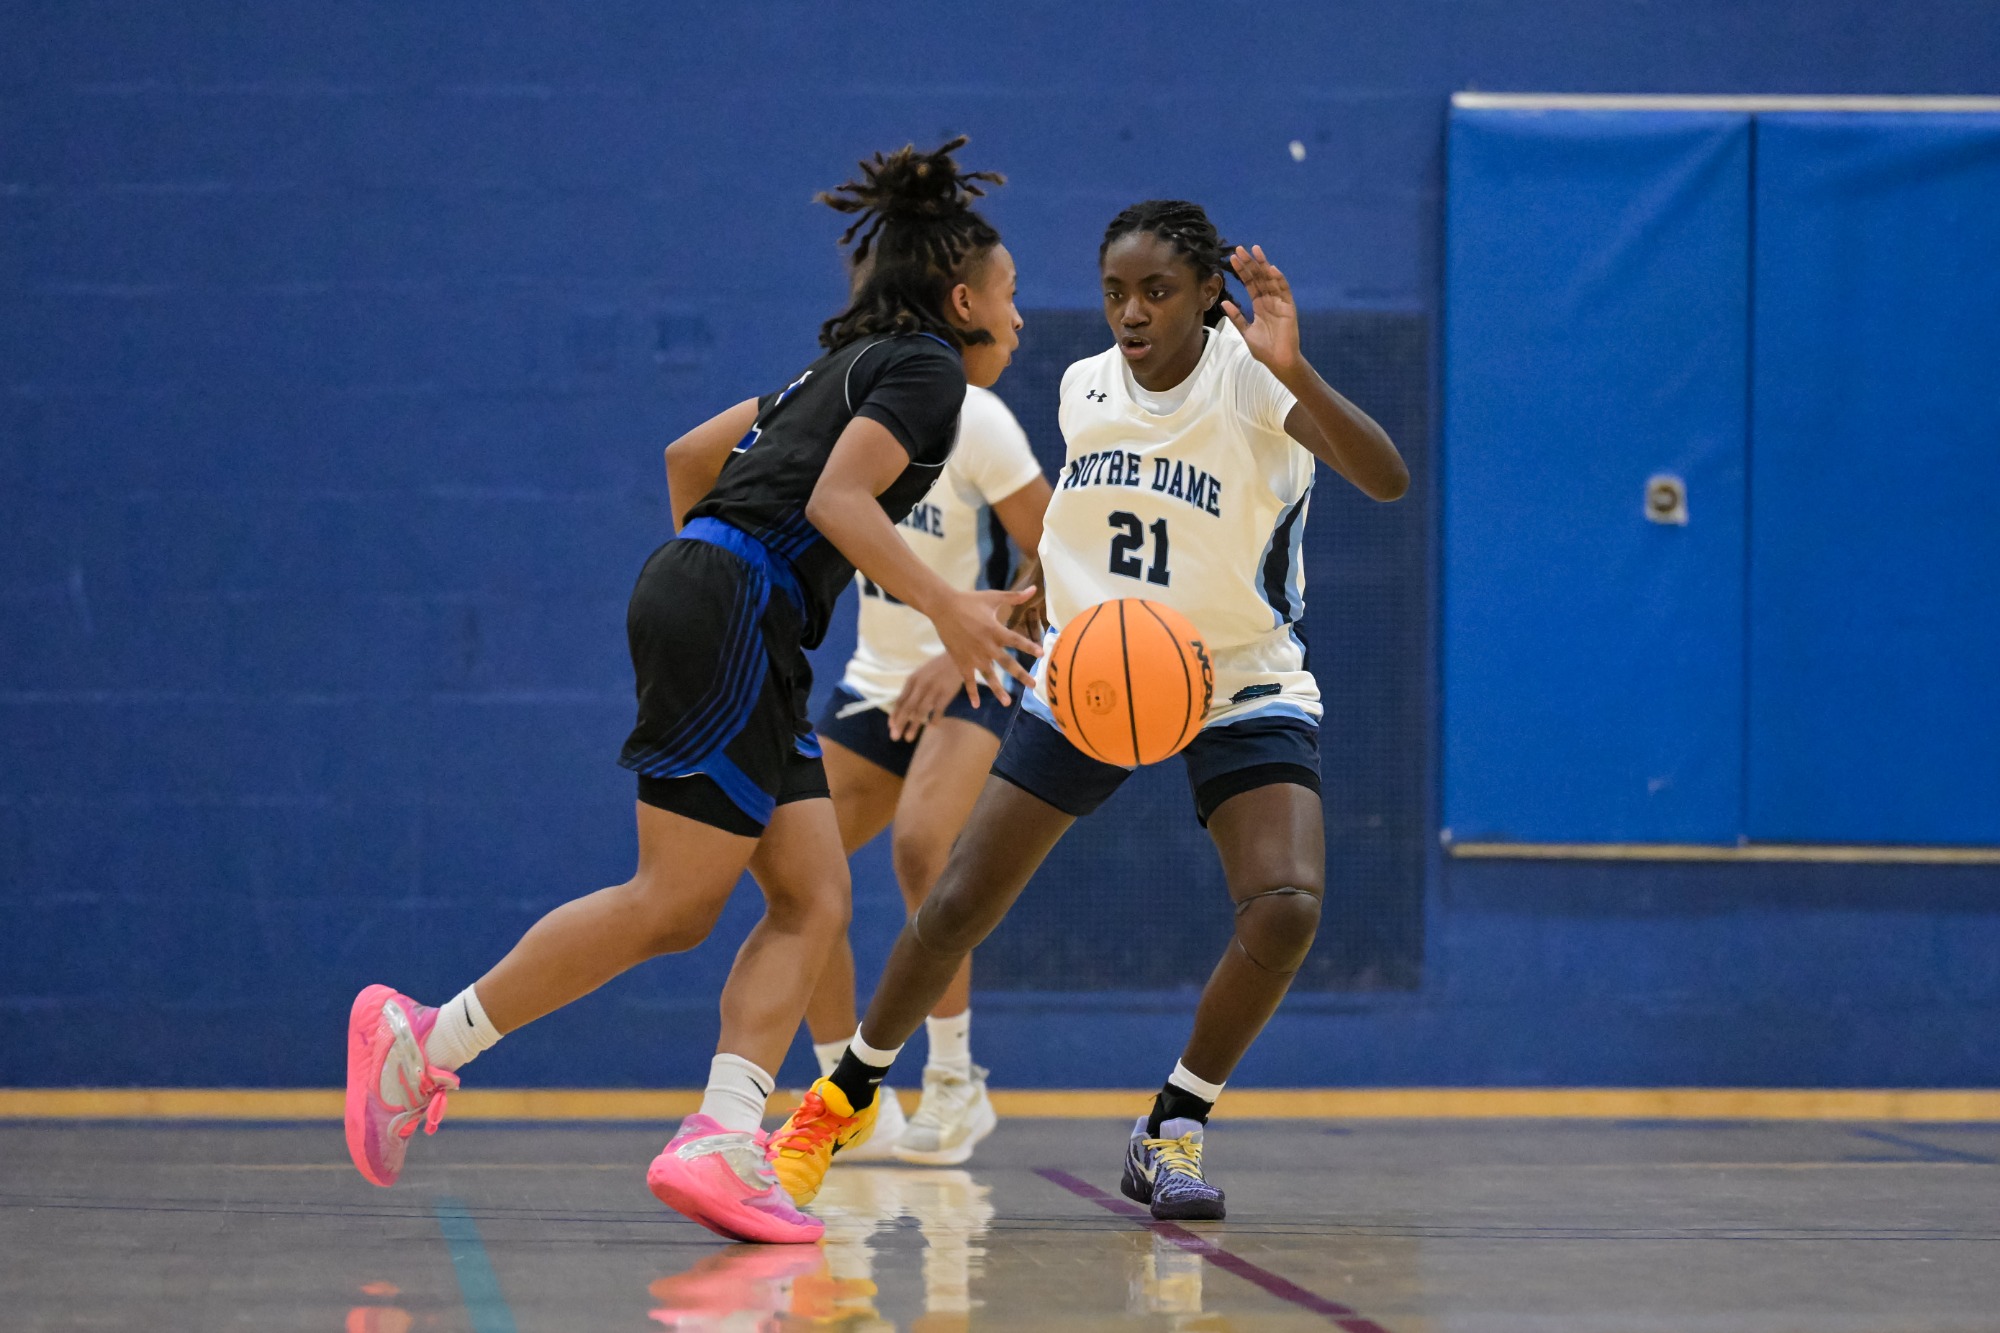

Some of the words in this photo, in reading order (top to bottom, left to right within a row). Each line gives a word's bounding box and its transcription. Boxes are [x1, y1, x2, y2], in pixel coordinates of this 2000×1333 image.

[1063, 449, 1142, 490] NOTRE
[1151, 457, 1222, 518] DAME
[1107, 510, 1171, 588] 21
